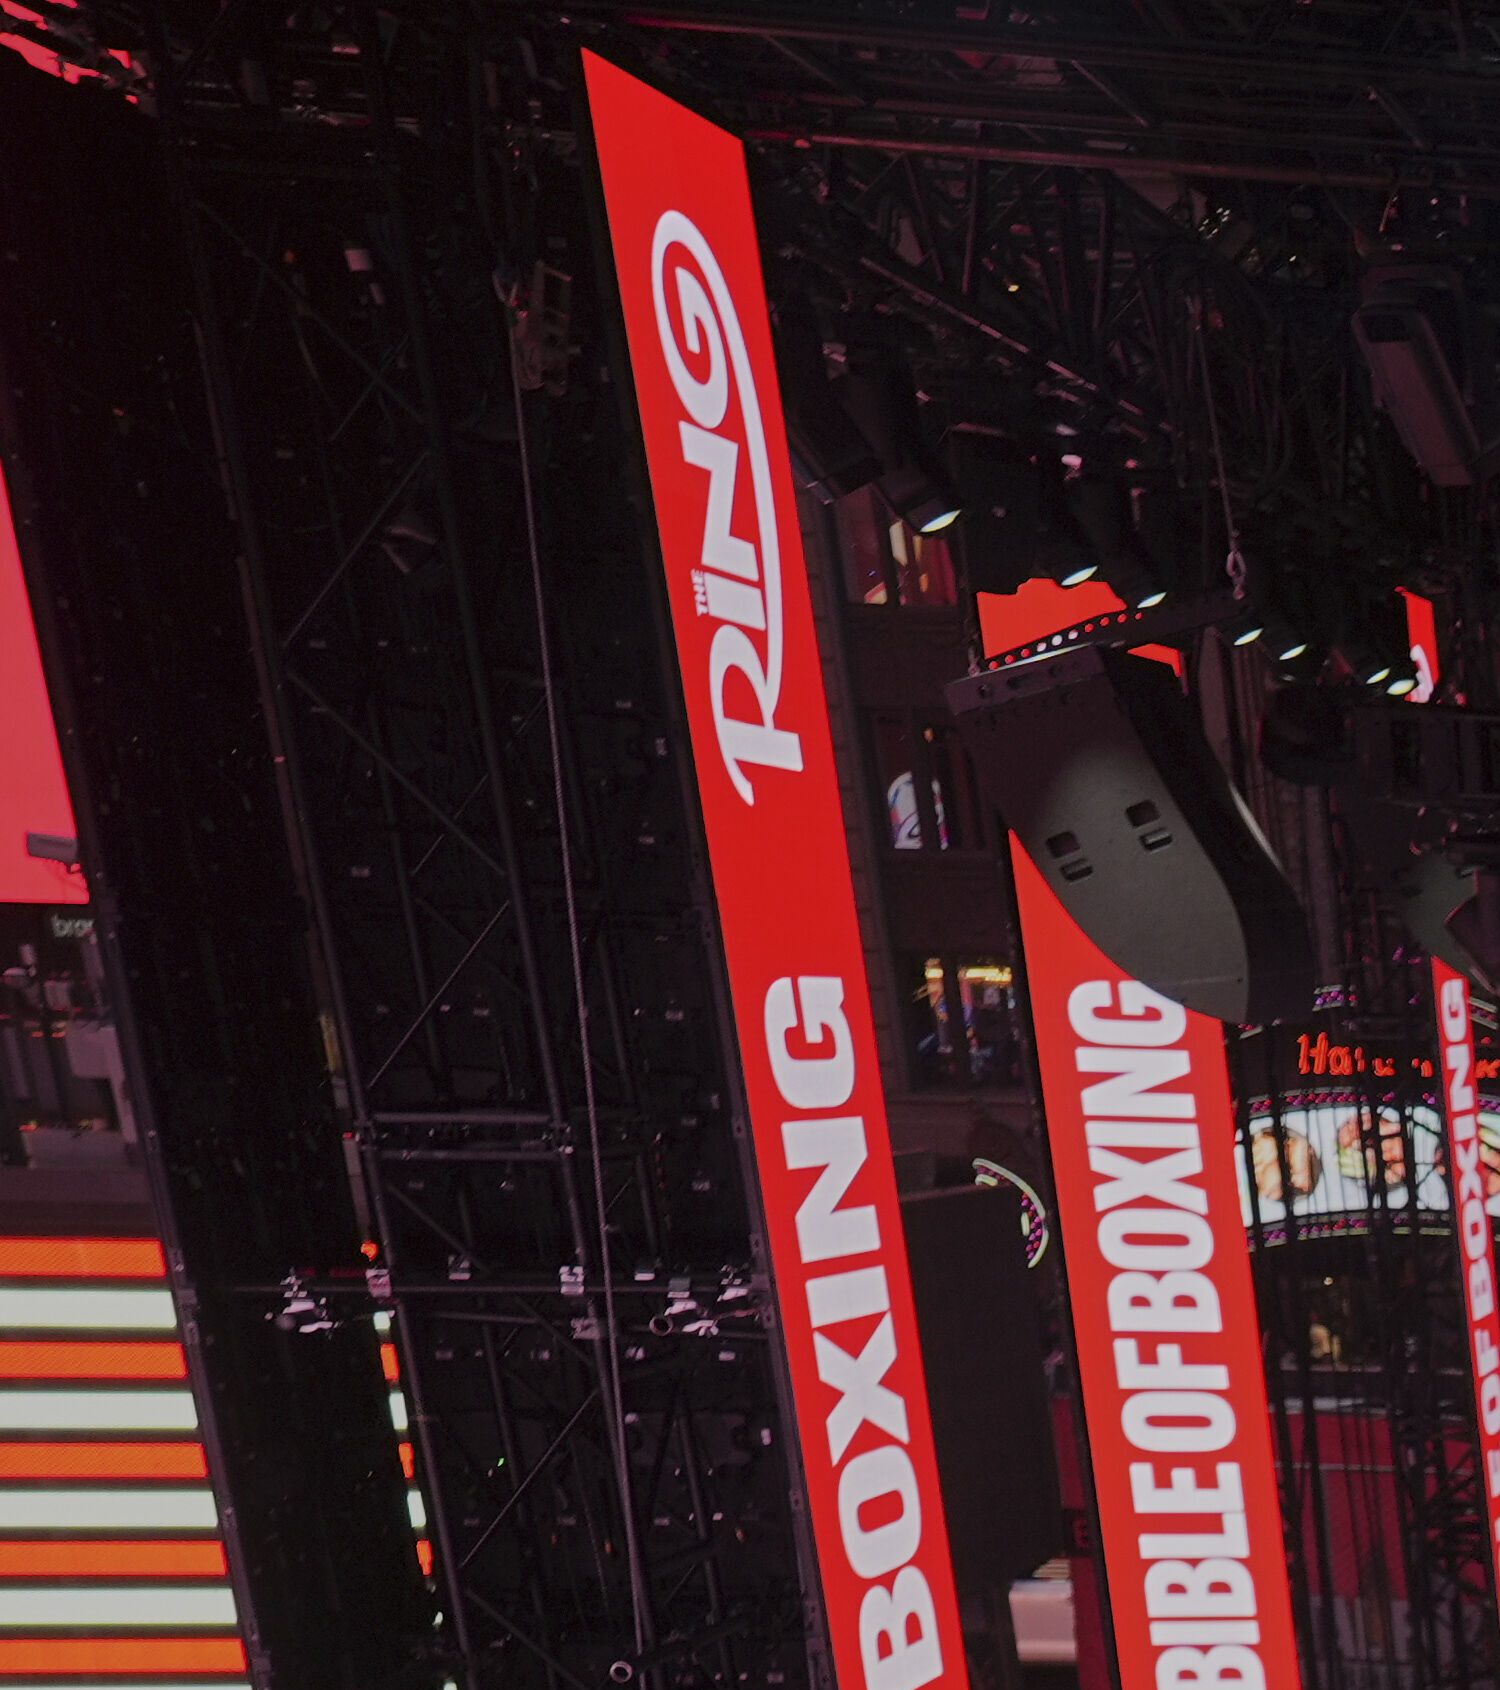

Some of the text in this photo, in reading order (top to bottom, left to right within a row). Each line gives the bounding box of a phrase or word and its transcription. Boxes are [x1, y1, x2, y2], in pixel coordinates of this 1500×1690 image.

[652, 211, 803, 805] RING
[692, 569, 709, 617] THE
[1068, 981, 1222, 1332] BOXING
[1442, 980, 1493, 1320] BOXING
[1114, 1339, 1238, 1455] OF
